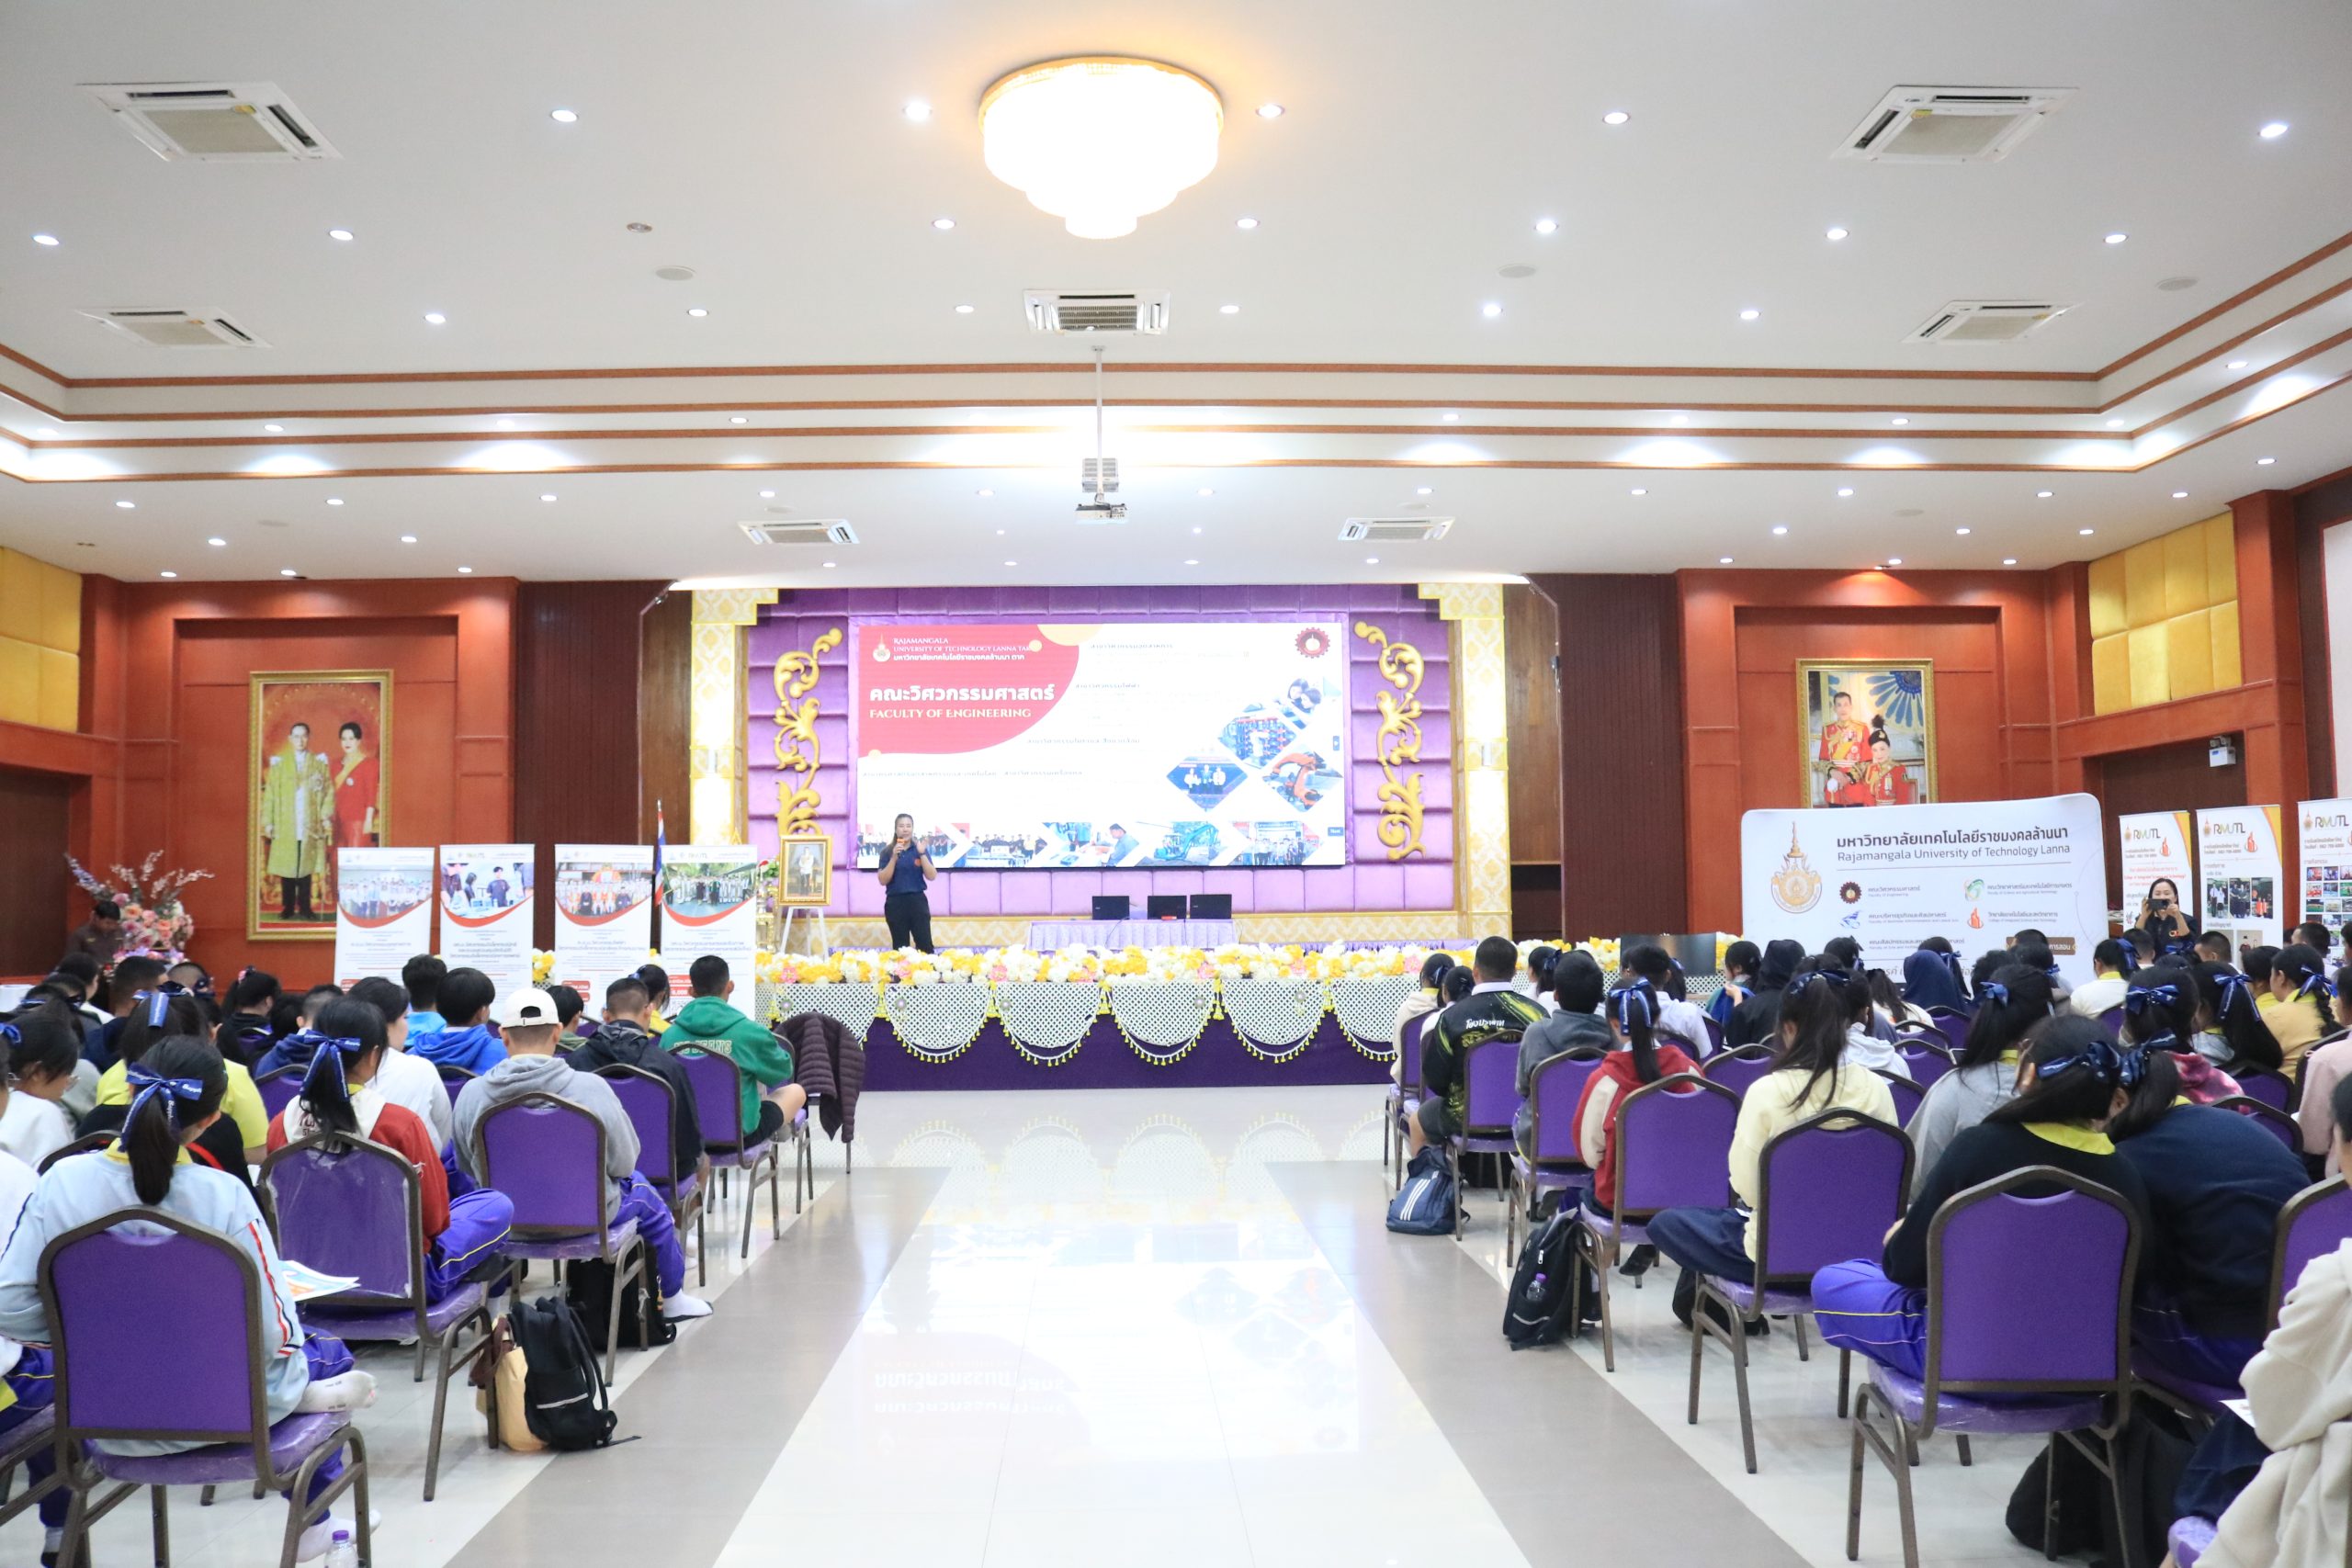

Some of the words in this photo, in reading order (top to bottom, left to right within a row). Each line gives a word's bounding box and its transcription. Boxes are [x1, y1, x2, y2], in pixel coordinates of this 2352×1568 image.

[869, 683, 1056, 702] คณะวิศวกรรมศาสตร์
[869, 709, 924, 718] FACULTY
[926, 709, 943, 718] OF
[945, 709, 1032, 718] ENGINEERING
[1837, 826, 2068, 848] มหาวิทยาลัยเทคโนโลยีราชมงคลล้านนา
[1838, 850, 1912, 864] Rajamangala
[1914, 848, 1969, 860] University
[1972, 847, 1982, 858] of
[1984, 845, 2038, 857] Technology
[2041, 844, 2070, 854] Lanna
